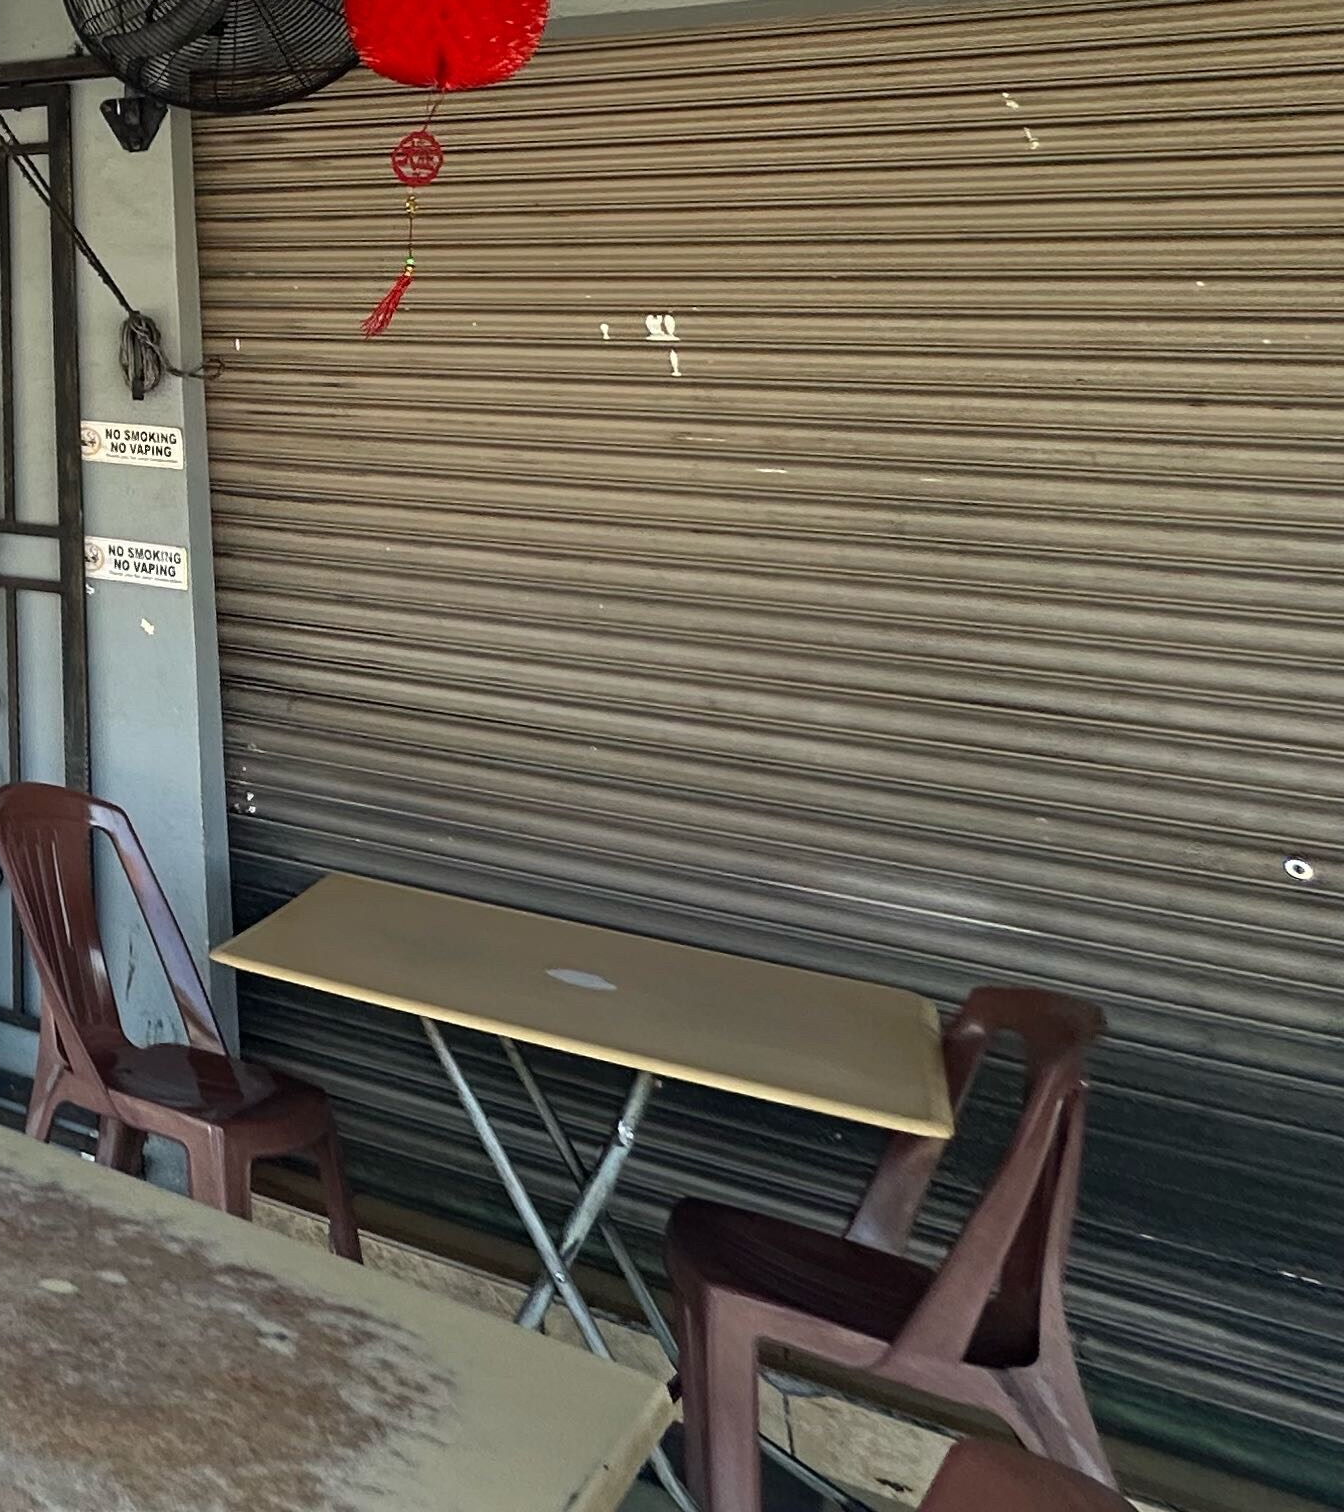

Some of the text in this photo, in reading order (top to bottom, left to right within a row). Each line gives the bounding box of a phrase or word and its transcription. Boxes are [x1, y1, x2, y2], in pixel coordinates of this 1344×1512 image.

[105, 428, 177, 445] NO SMOKING
[110, 441, 172, 457] NO VAPING
[108, 544, 181, 565] NO SMOKING
[114, 558, 130, 571] NO
[133, 560, 176, 577] VAPING
